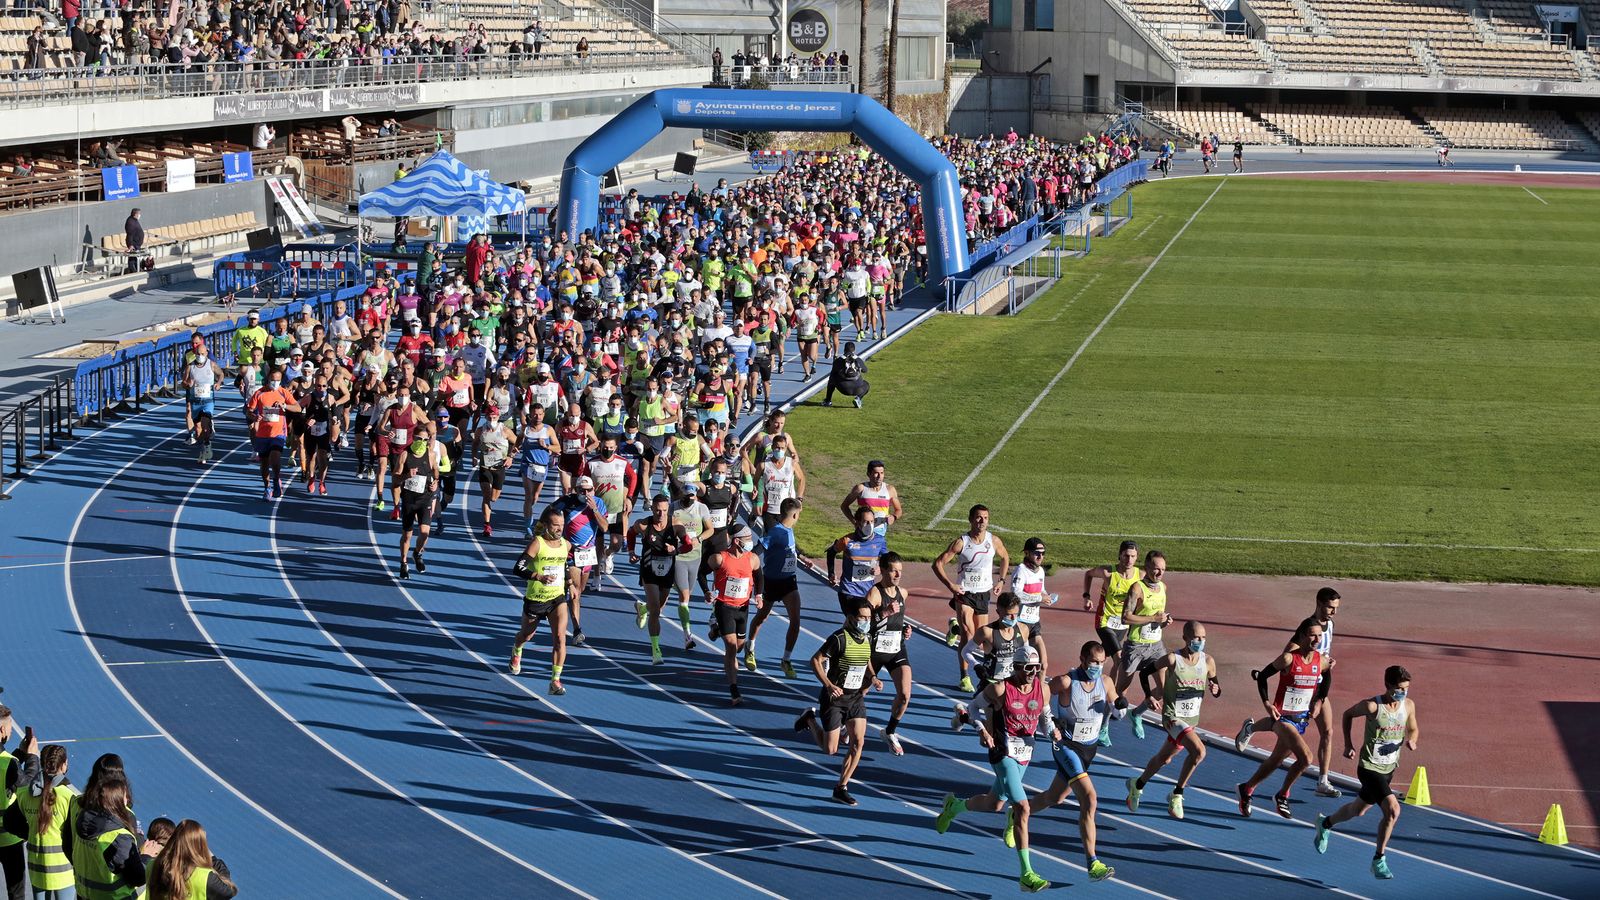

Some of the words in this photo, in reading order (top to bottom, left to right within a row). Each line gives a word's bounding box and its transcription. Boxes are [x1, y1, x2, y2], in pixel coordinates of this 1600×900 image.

[695, 101, 784, 111] Ayuntamiento
[785, 103, 801, 111] de
[804, 104, 837, 112] Jerez
[730, 584, 742, 593] 226
[1290, 697, 1303, 705] 110
[1181, 702, 1194, 710] 362
[1079, 726, 1093, 735] 421
